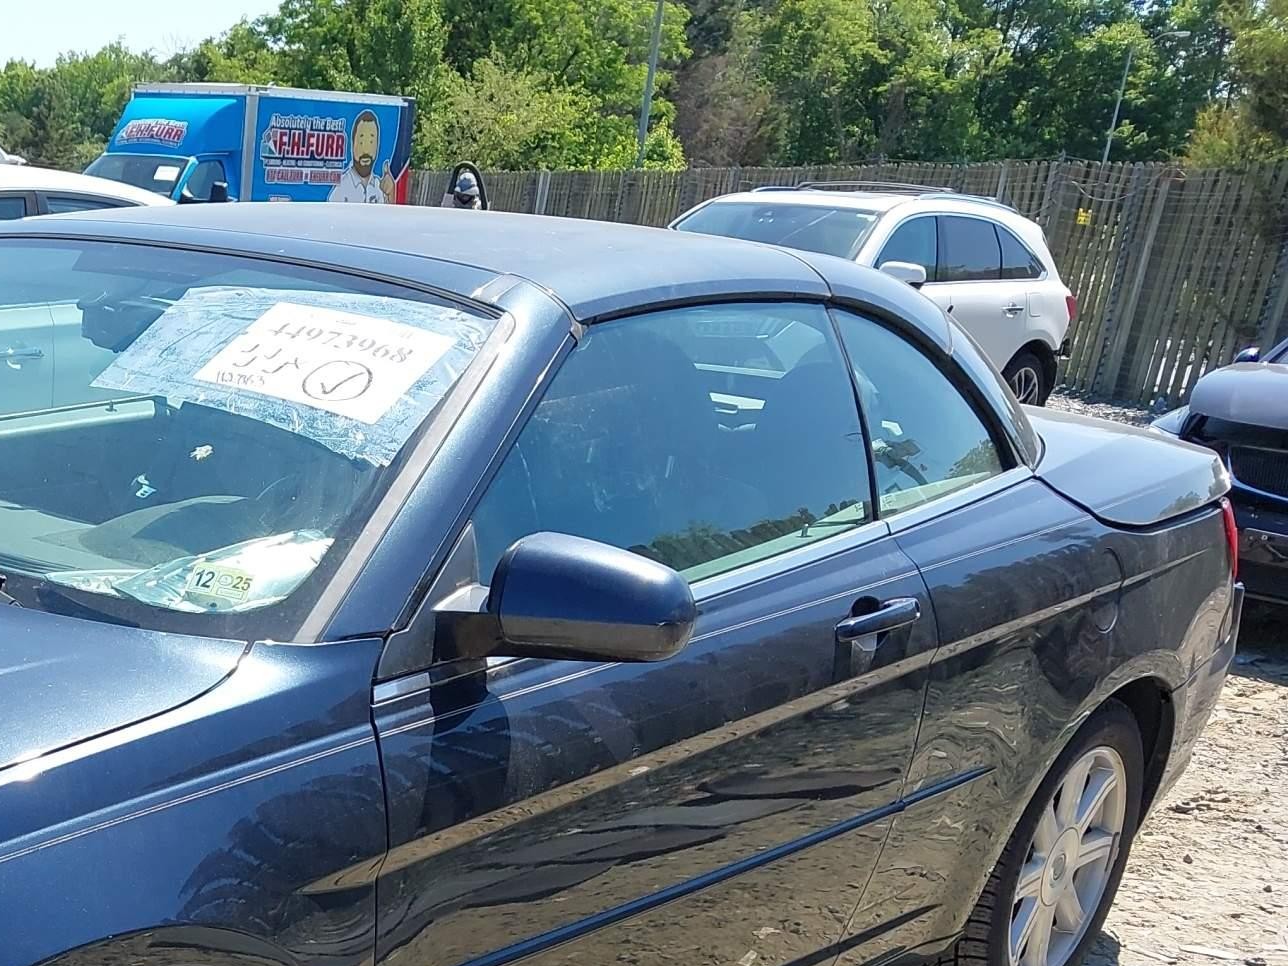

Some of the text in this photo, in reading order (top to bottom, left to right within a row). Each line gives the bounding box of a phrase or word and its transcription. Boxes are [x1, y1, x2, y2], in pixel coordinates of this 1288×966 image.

[271, 115, 345, 131] Absolutely the Best!
[268, 322, 414, 364] 44973968
[195, 569, 253, 591] 12 25
